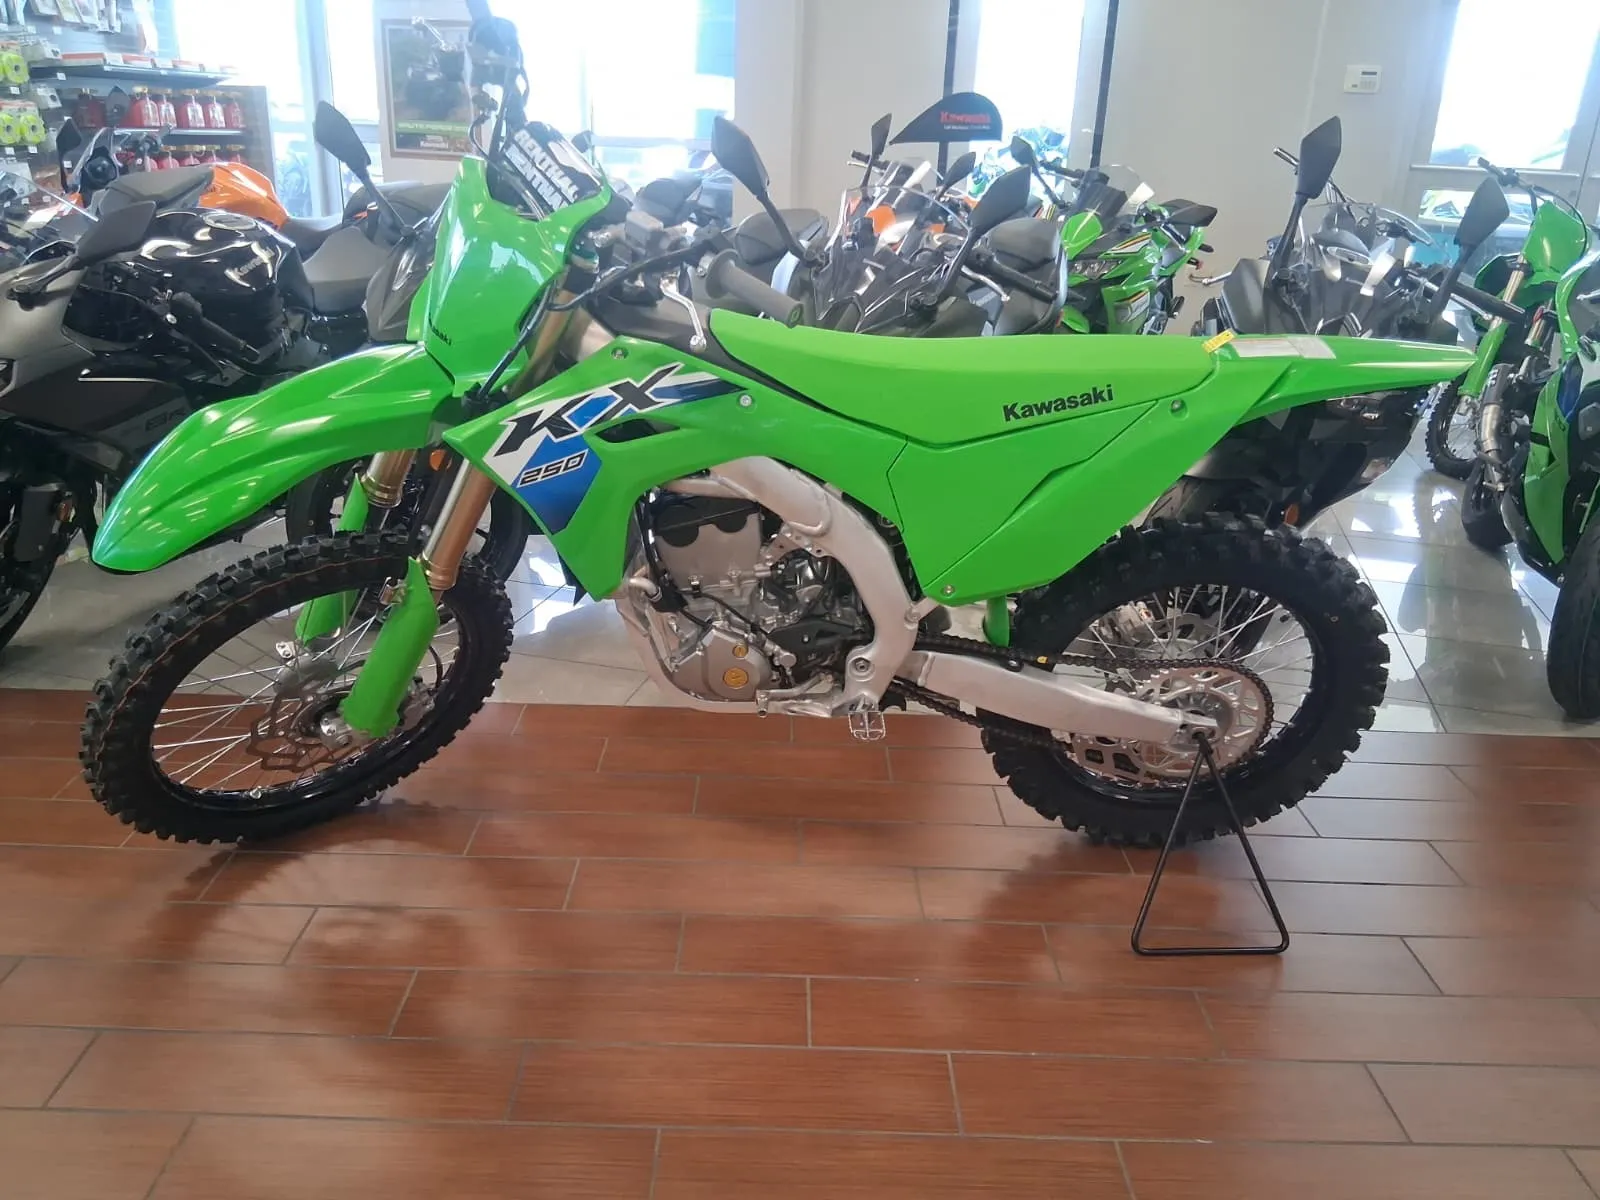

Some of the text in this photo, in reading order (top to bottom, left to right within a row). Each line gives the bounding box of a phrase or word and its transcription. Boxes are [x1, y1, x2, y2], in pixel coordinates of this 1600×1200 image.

[514, 129, 579, 204] RENTHAL
[493, 363, 683, 457] KX
[1003, 383, 1114, 422] Kawasaki
[518, 450, 588, 487] 250
